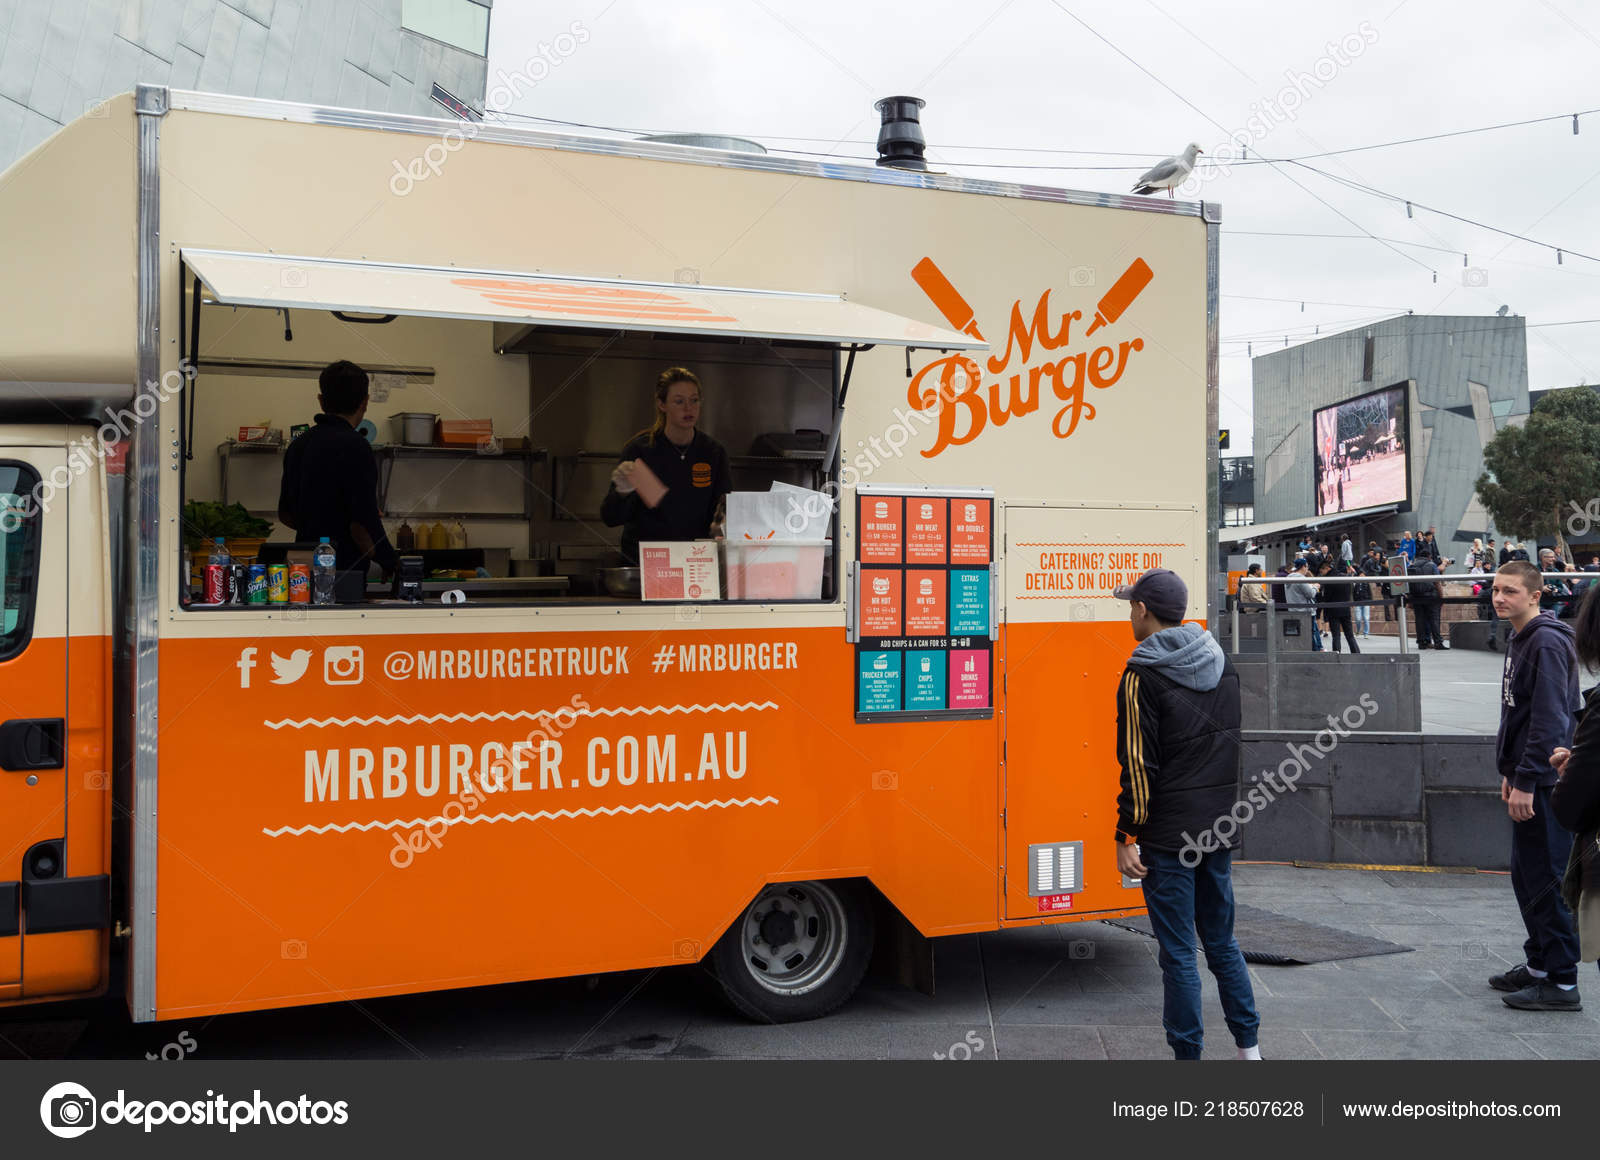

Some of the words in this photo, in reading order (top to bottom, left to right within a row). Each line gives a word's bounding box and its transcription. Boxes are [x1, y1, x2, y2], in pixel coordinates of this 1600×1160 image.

[987, 288, 1082, 374] Mr
[907, 337, 1144, 458] Burger
[1040, 552, 1105, 570] CATERING?
[1108, 552, 1139, 570] SURE
[1143, 552, 1162, 570] DO!
[1025, 572, 1074, 591] DETAILS
[1078, 572, 1095, 590] ON
[1099, 572, 1122, 590] OUR
[880, 640, 891, 648] ADD
[892, 640, 908, 648] CHIPS
[383, 645, 629, 681] @MRBURGERTRUCK
[651, 642, 798, 673] #MRBURGER
[862, 671, 884, 679] TRUCKER
[884, 671, 899, 679] CHIPS
[304, 730, 749, 802] MRBURGER.COM.AU
